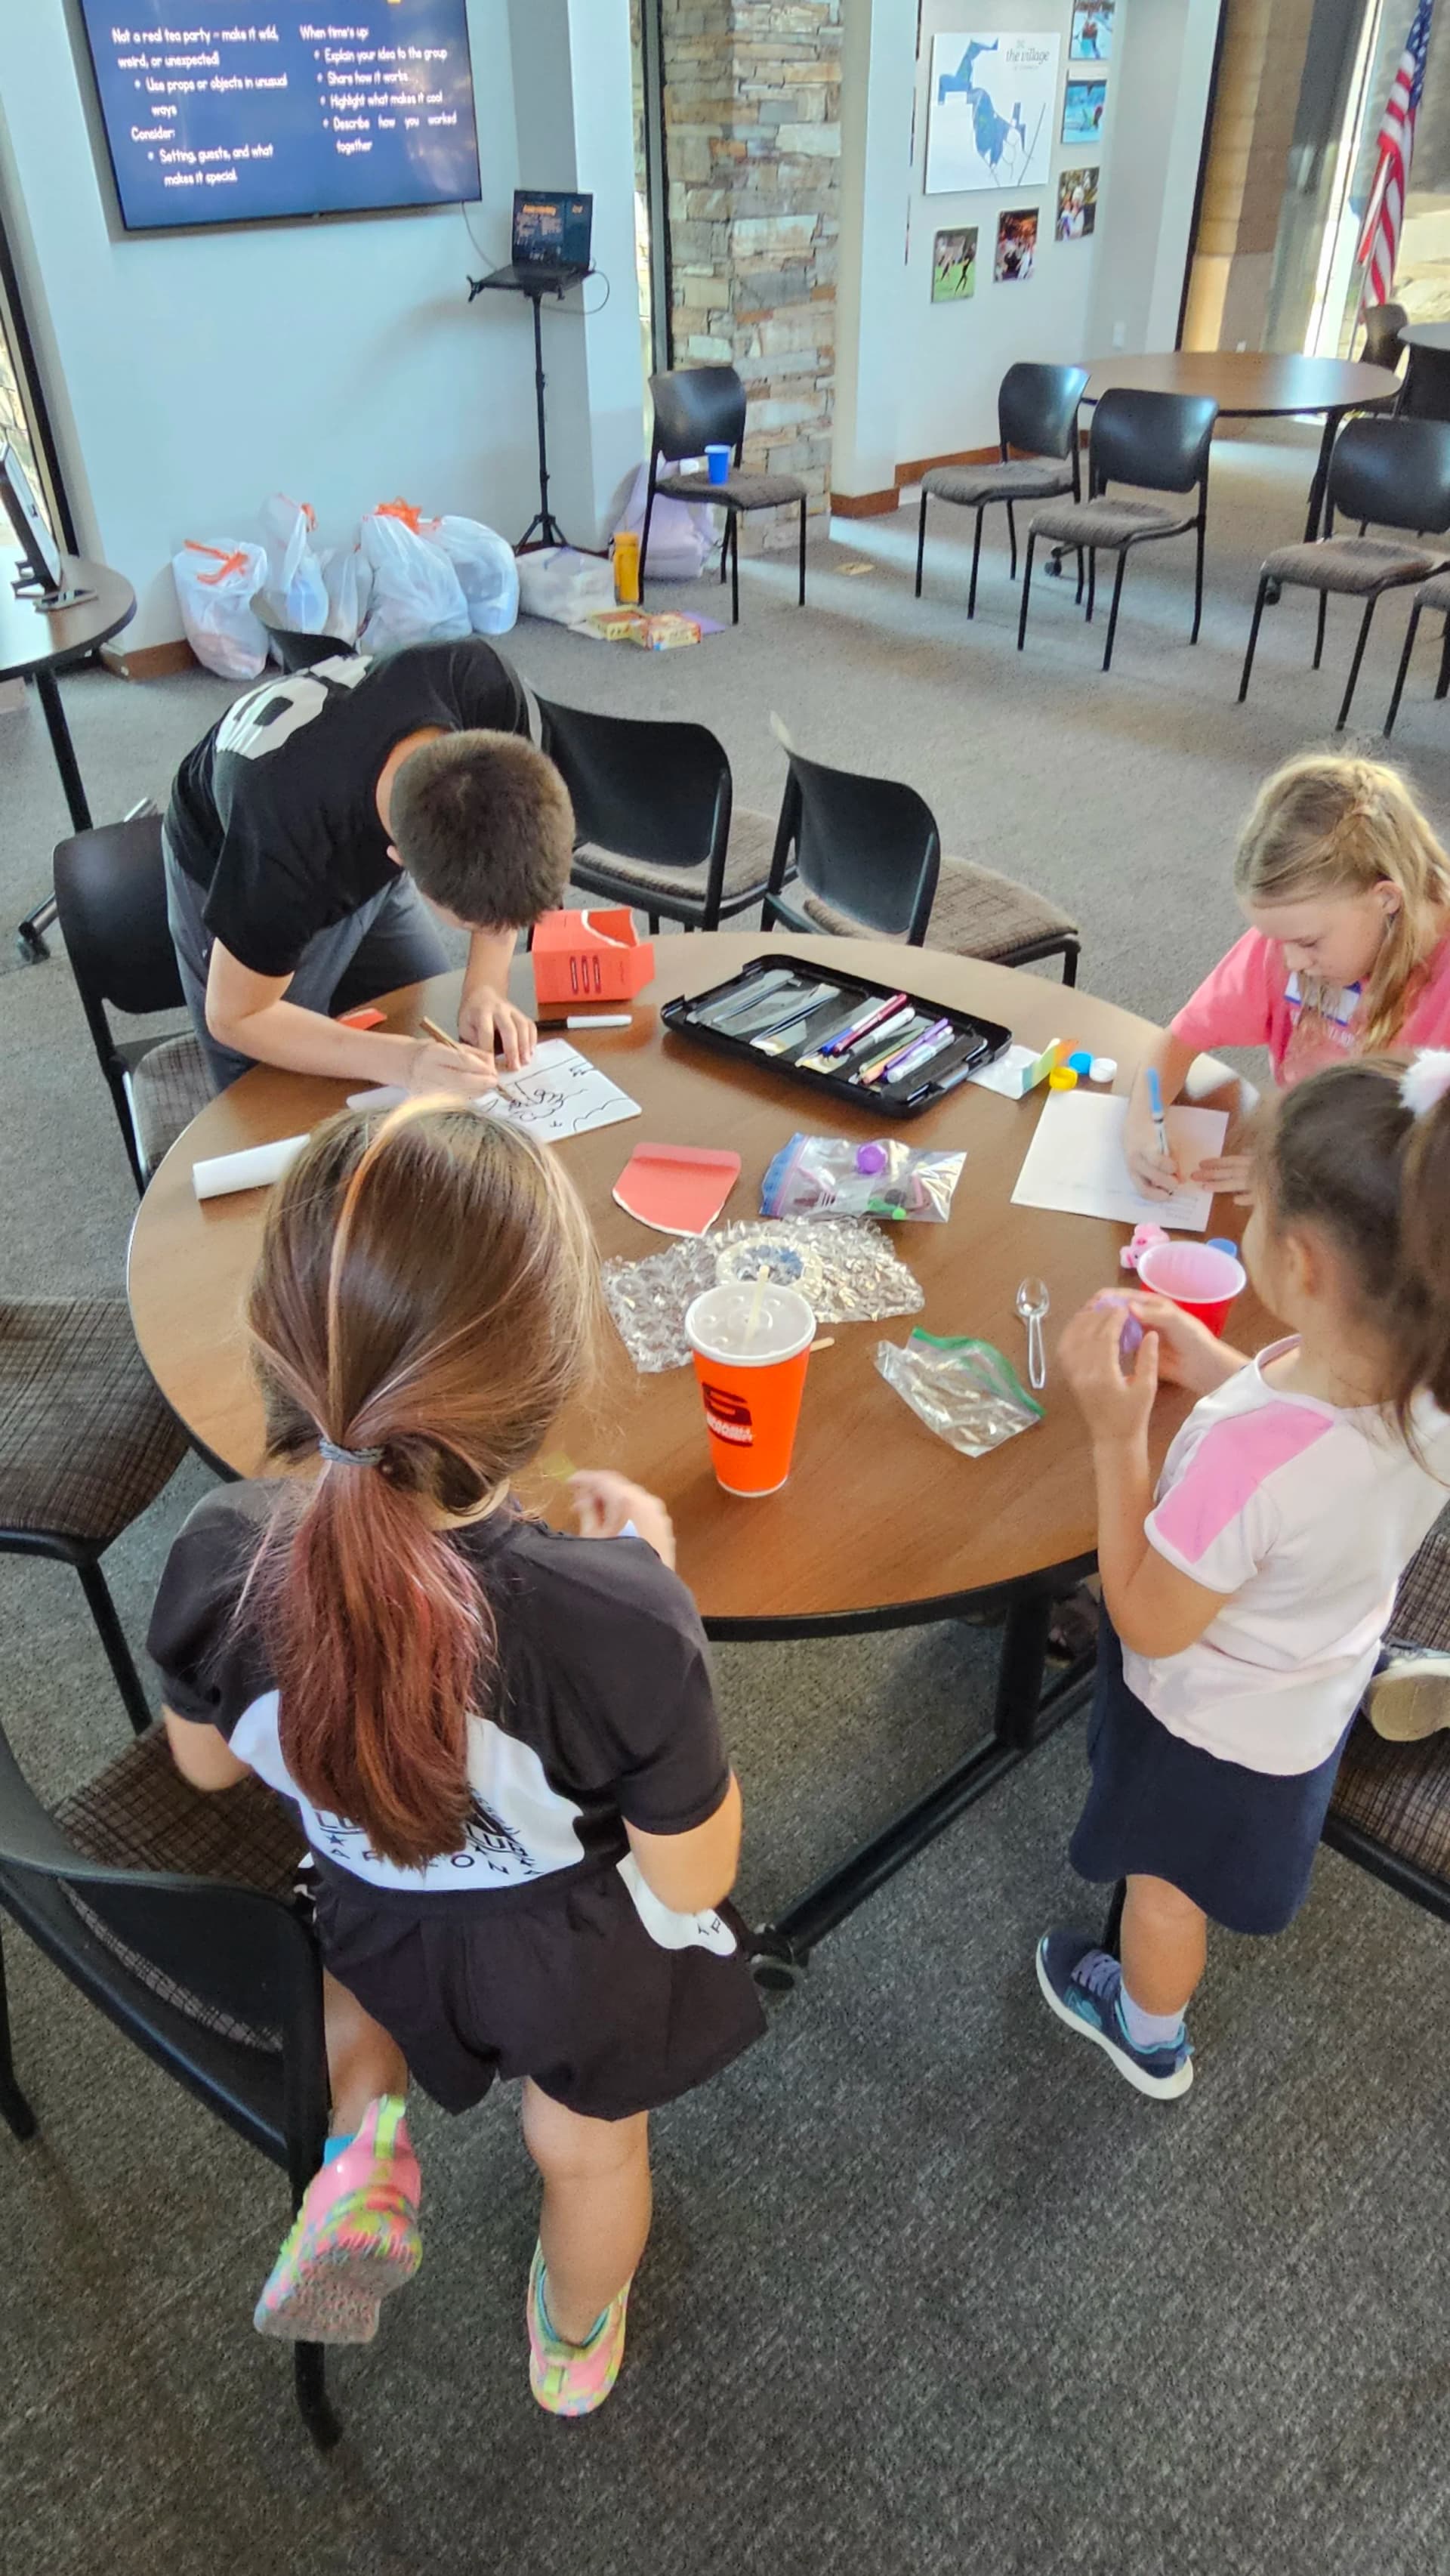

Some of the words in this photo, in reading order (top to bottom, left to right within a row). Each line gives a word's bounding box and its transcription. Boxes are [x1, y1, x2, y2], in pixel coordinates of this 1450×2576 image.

[113, 27, 130, 43] Not
[134, 32, 140, 42] a
[143, 27, 162, 42] real
[164, 28, 181, 42] tea
[184, 27, 210, 45] party
[222, 26, 246, 42] make
[248, 26, 256, 40] it
[300, 24, 325, 41] When
[328, 24, 354, 38] time's
[118, 52, 149, 69] weird,
[150, 57, 162, 67] or
[325, 48, 354, 65] Explain
[356, 50, 376, 65] your
[378, 46, 396, 60] idea
[397, 46, 406, 59] to
[409, 45, 422, 59] the
[424, 48, 448, 63] group
[1006, 48, 1020, 62] the
[1021, 48, 1050, 65] village
[146, 77, 165, 92] Use
[167, 79, 195, 94] props
[196, 79, 208, 89] or
[210, 75, 242, 92] objects
[245, 76, 253, 88] in
[255, 73, 288, 88] unusual
[327, 71, 353, 86] Share
[355, 69, 372, 85] how
[374, 70, 381, 84] it
[330, 92, 366, 110] Highlight
[367, 91, 389, 109] what
[390, 91, 416, 105] makes
[418, 91, 424, 103] it
[426, 89, 443, 103] cool
[152, 105, 177, 119] ways
[333, 115, 370, 131] Describe
[378, 113, 396, 128] how
[404, 116, 420, 131] you
[427, 109, 457, 126] worked
[131, 125, 175, 141] Consider:
[199, 145, 231, 165] guests,
[233, 143, 250, 158] and
[251, 143, 273, 158] what
[336, 137, 372, 156] together
[164, 171, 193, 187] makes
[196, 170, 203, 184] it
